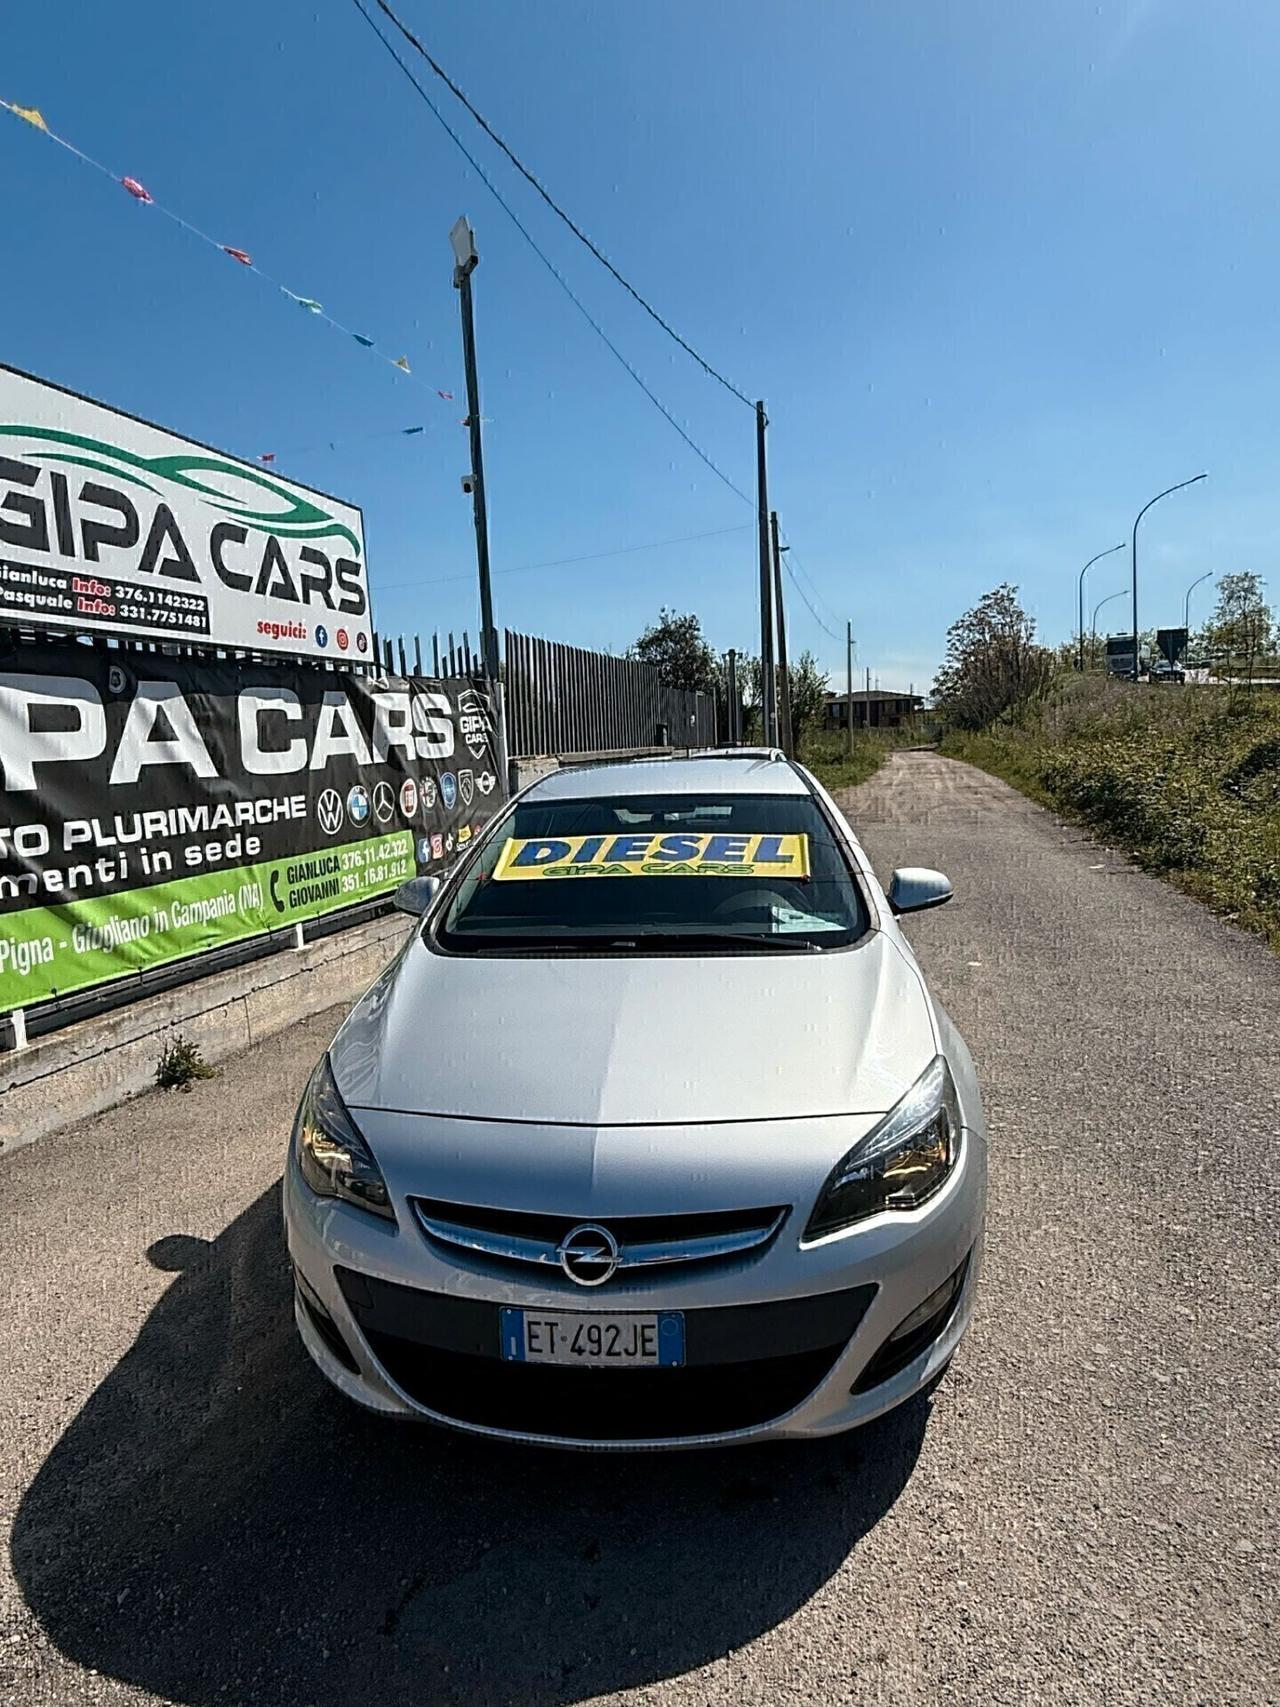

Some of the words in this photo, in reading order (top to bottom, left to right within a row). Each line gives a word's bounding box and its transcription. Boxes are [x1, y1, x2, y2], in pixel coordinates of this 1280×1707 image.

[0, 455, 202, 584] GIPA
[210, 522, 366, 616] CARS
[0, 565, 67, 589] ianluca
[72, 577, 111, 597] Info:
[115, 586, 205, 611] 376.1142322
[77, 597, 116, 617] Info:
[119, 604, 207, 627] 331.7751481
[257, 620, 307, 640] seguici:
[237, 687, 454, 775] CARS
[63, 795, 306, 851] PLURIMARCHE
[0, 852, 127, 900] menti
[141, 846, 173, 875] in
[185, 832, 261, 867] sede
[287, 855, 341, 885] GIANLUCA
[342, 838, 408, 870] 376.11.42.322
[510, 834, 795, 868] DIESEL
[542, 863, 633, 877] GIPA
[640, 861, 755, 876] CARS
[289, 878, 340, 908] GIOVANNI
[342, 859, 408, 892] 351.16.81.912
[0, 936, 54, 976] Pigna
[72, 914, 150, 954] Giugliano
[154, 906, 169, 933] in
[171, 893, 236, 928] Campania
[239, 883, 264, 916] (NA)
[527, 1320, 559, 1354] ET
[570, 1323, 657, 1357] 492JE
